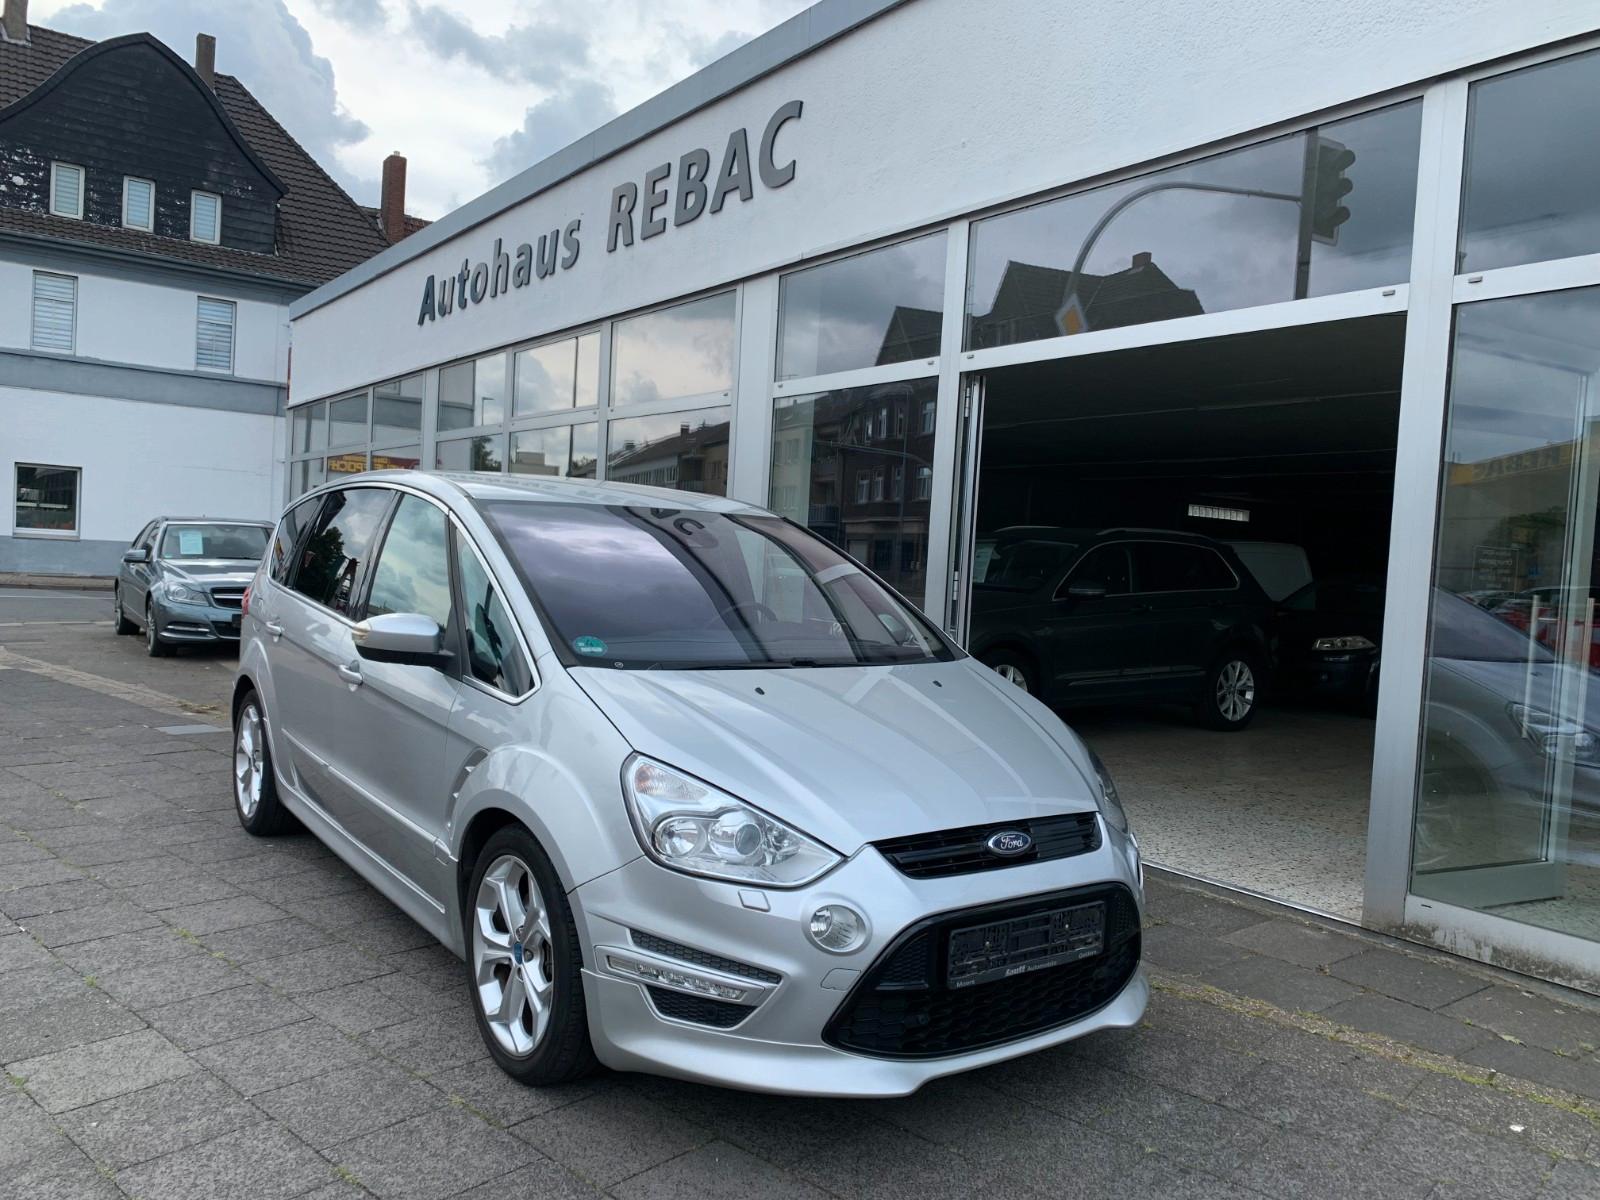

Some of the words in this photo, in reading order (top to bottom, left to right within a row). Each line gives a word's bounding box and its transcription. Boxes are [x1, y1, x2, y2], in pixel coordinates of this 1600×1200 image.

[417, 219, 582, 326] Autohaus
[606, 99, 804, 253] REBAC
[1000, 834, 1024, 850] Ford
